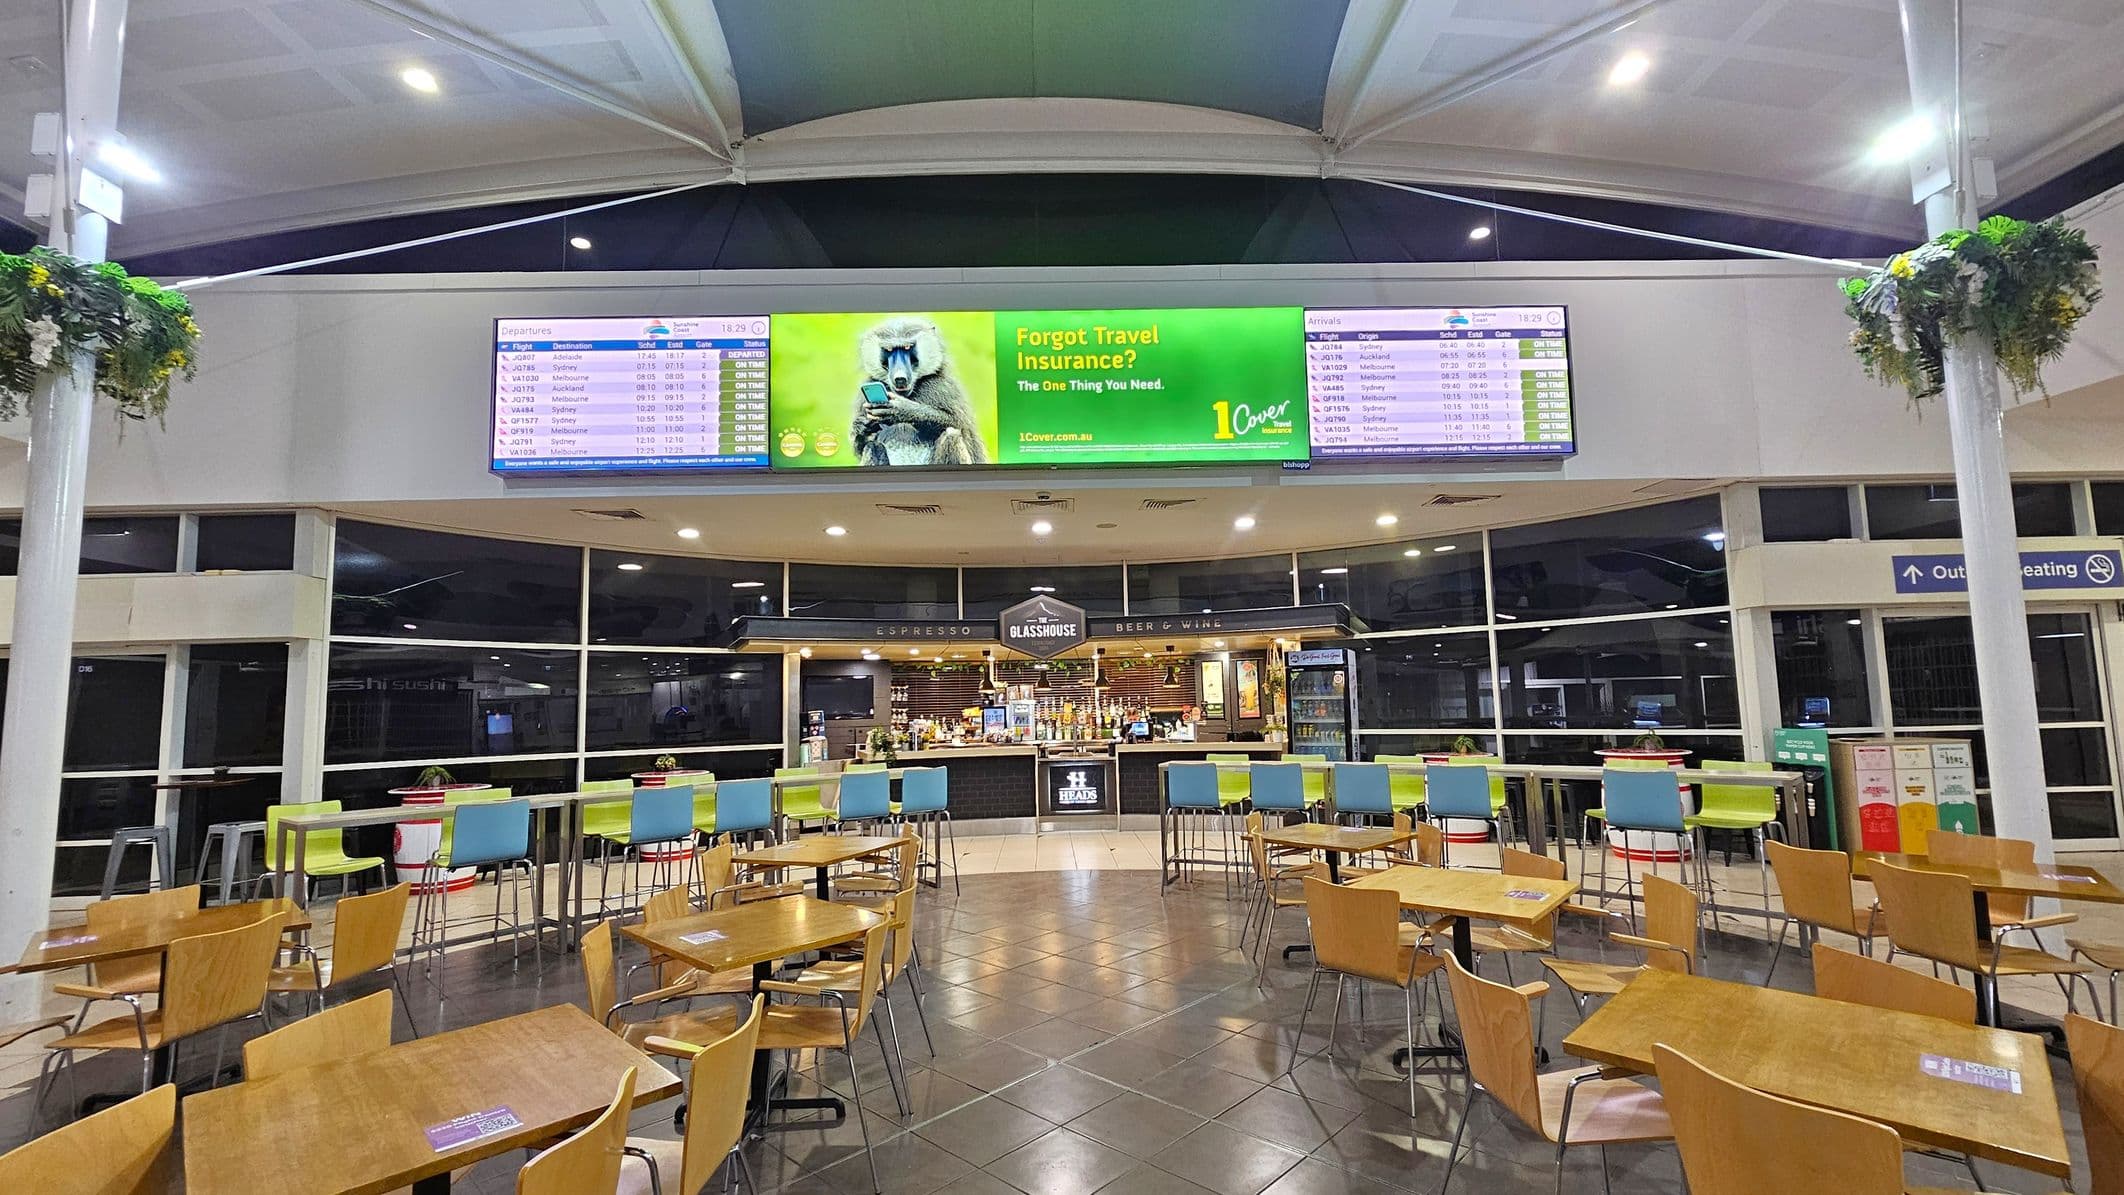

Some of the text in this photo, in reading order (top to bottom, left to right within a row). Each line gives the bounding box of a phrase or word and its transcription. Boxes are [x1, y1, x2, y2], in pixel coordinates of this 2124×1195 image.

[1519, 314, 1541, 322] 18:29
[502, 327, 552, 336] Departures
[722, 324, 746, 333] 18:29
[1017, 324, 1159, 350] Forgot Travel
[1358, 333, 1379, 341] Origin
[512, 343, 532, 351] Flight
[1018, 349, 1136, 370] Insurance?
[1017, 378, 1165, 393] The One Thing You Need.
[1019, 433, 1092, 441] 1Cover.com.au
[1932, 562, 2077, 579] Out eating
[1116, 619, 1221, 632] BEER & WINE
[877, 626, 970, 635] ESPRESSO
[1010, 624, 1076, 638] GLASSHOUSE
[1059, 790, 1097, 800] HEADS
